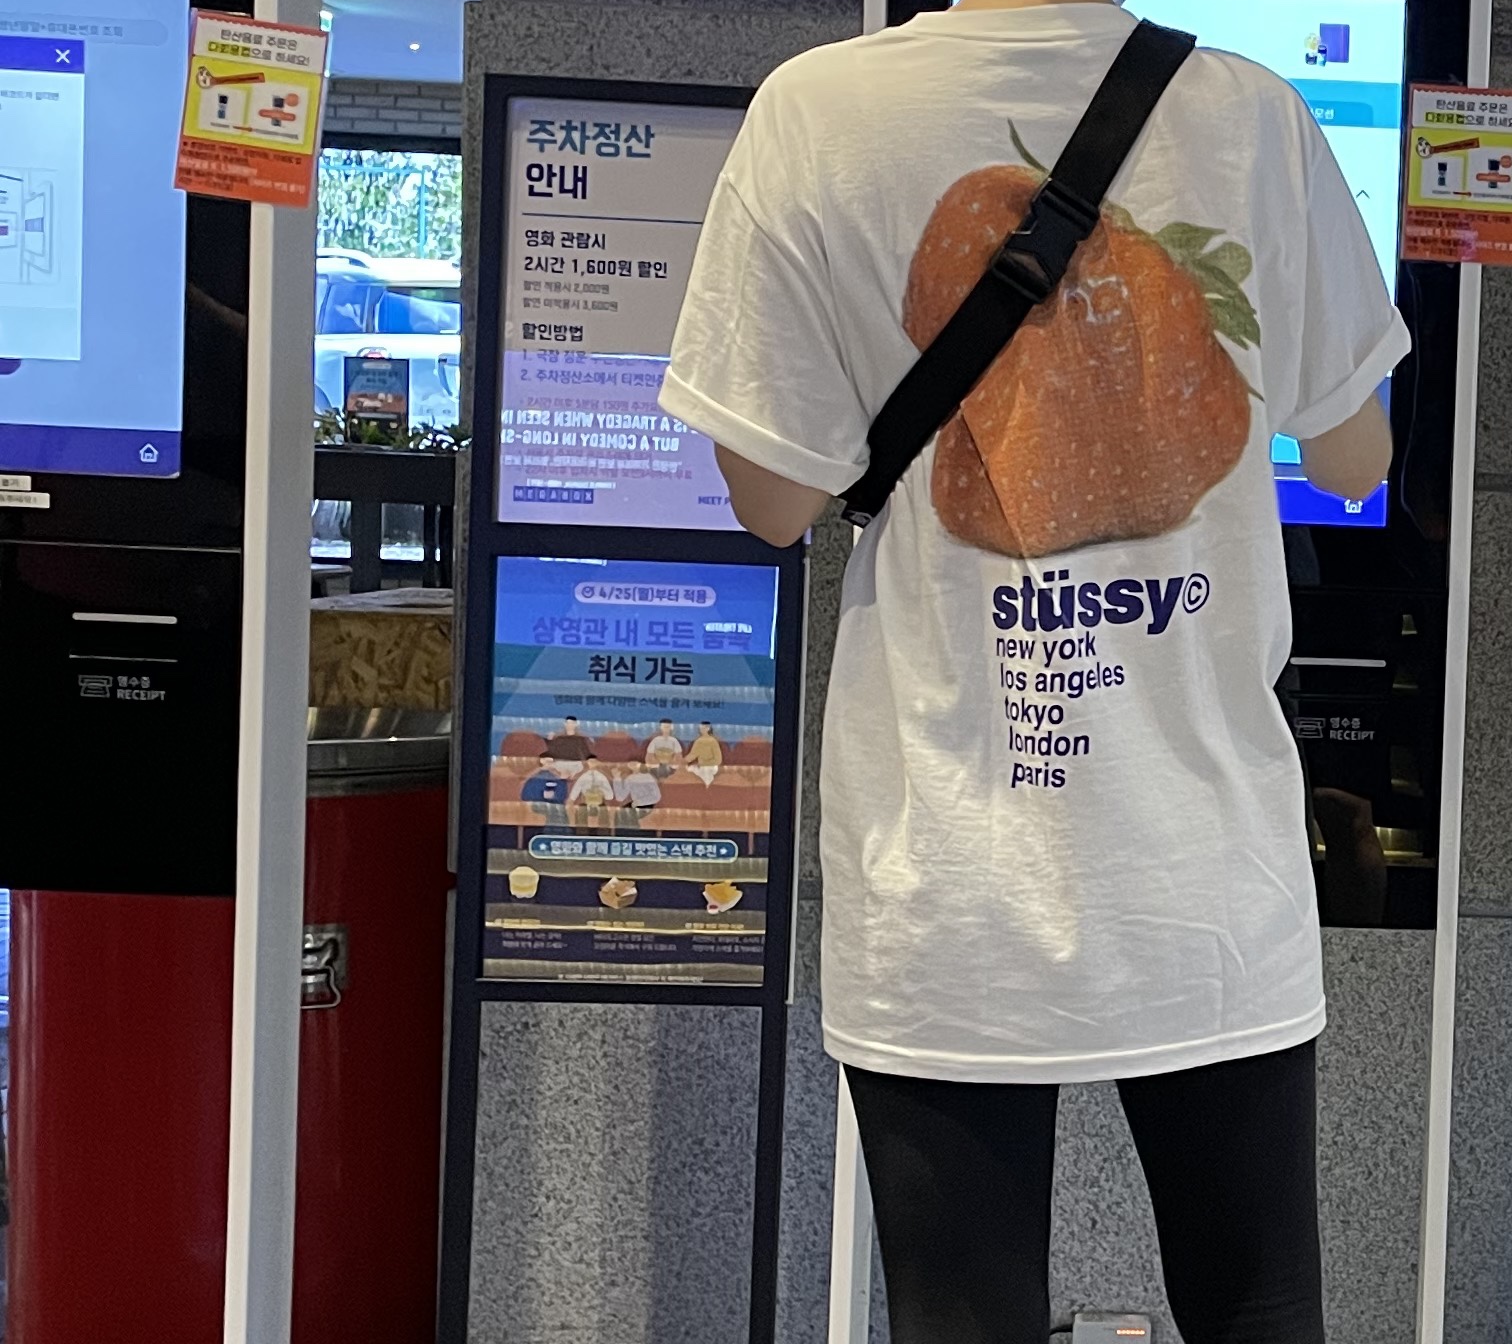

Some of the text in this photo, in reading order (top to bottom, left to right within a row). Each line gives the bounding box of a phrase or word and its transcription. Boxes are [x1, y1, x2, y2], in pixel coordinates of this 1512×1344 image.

[527, 119, 655, 158] 주차정산
[526, 163, 587, 199] 안내
[525, 230, 606, 250] 영화 관람시
[524, 257, 668, 279] 2시간 1,600원 할인
[523, 323, 583, 342] 할인방법
[536, 371, 618, 385] 주차정산소에서
[514, 488, 593, 503] MEGABOX
[533, 616, 607, 646] 상영관
[614, 619, 638, 646] 내
[649, 621, 695, 649] 모든
[997, 631, 1096, 667] new york
[588, 655, 694, 685] 취식 가능
[1000, 662, 1124, 698] los angeles
[117, 689, 166, 701] RECEIPT
[1004, 695, 1064, 731] tokyo
[1009, 726, 1090, 757] london
[1329, 730, 1375, 741] RECEIPT
[1011, 762, 1066, 788] paris
